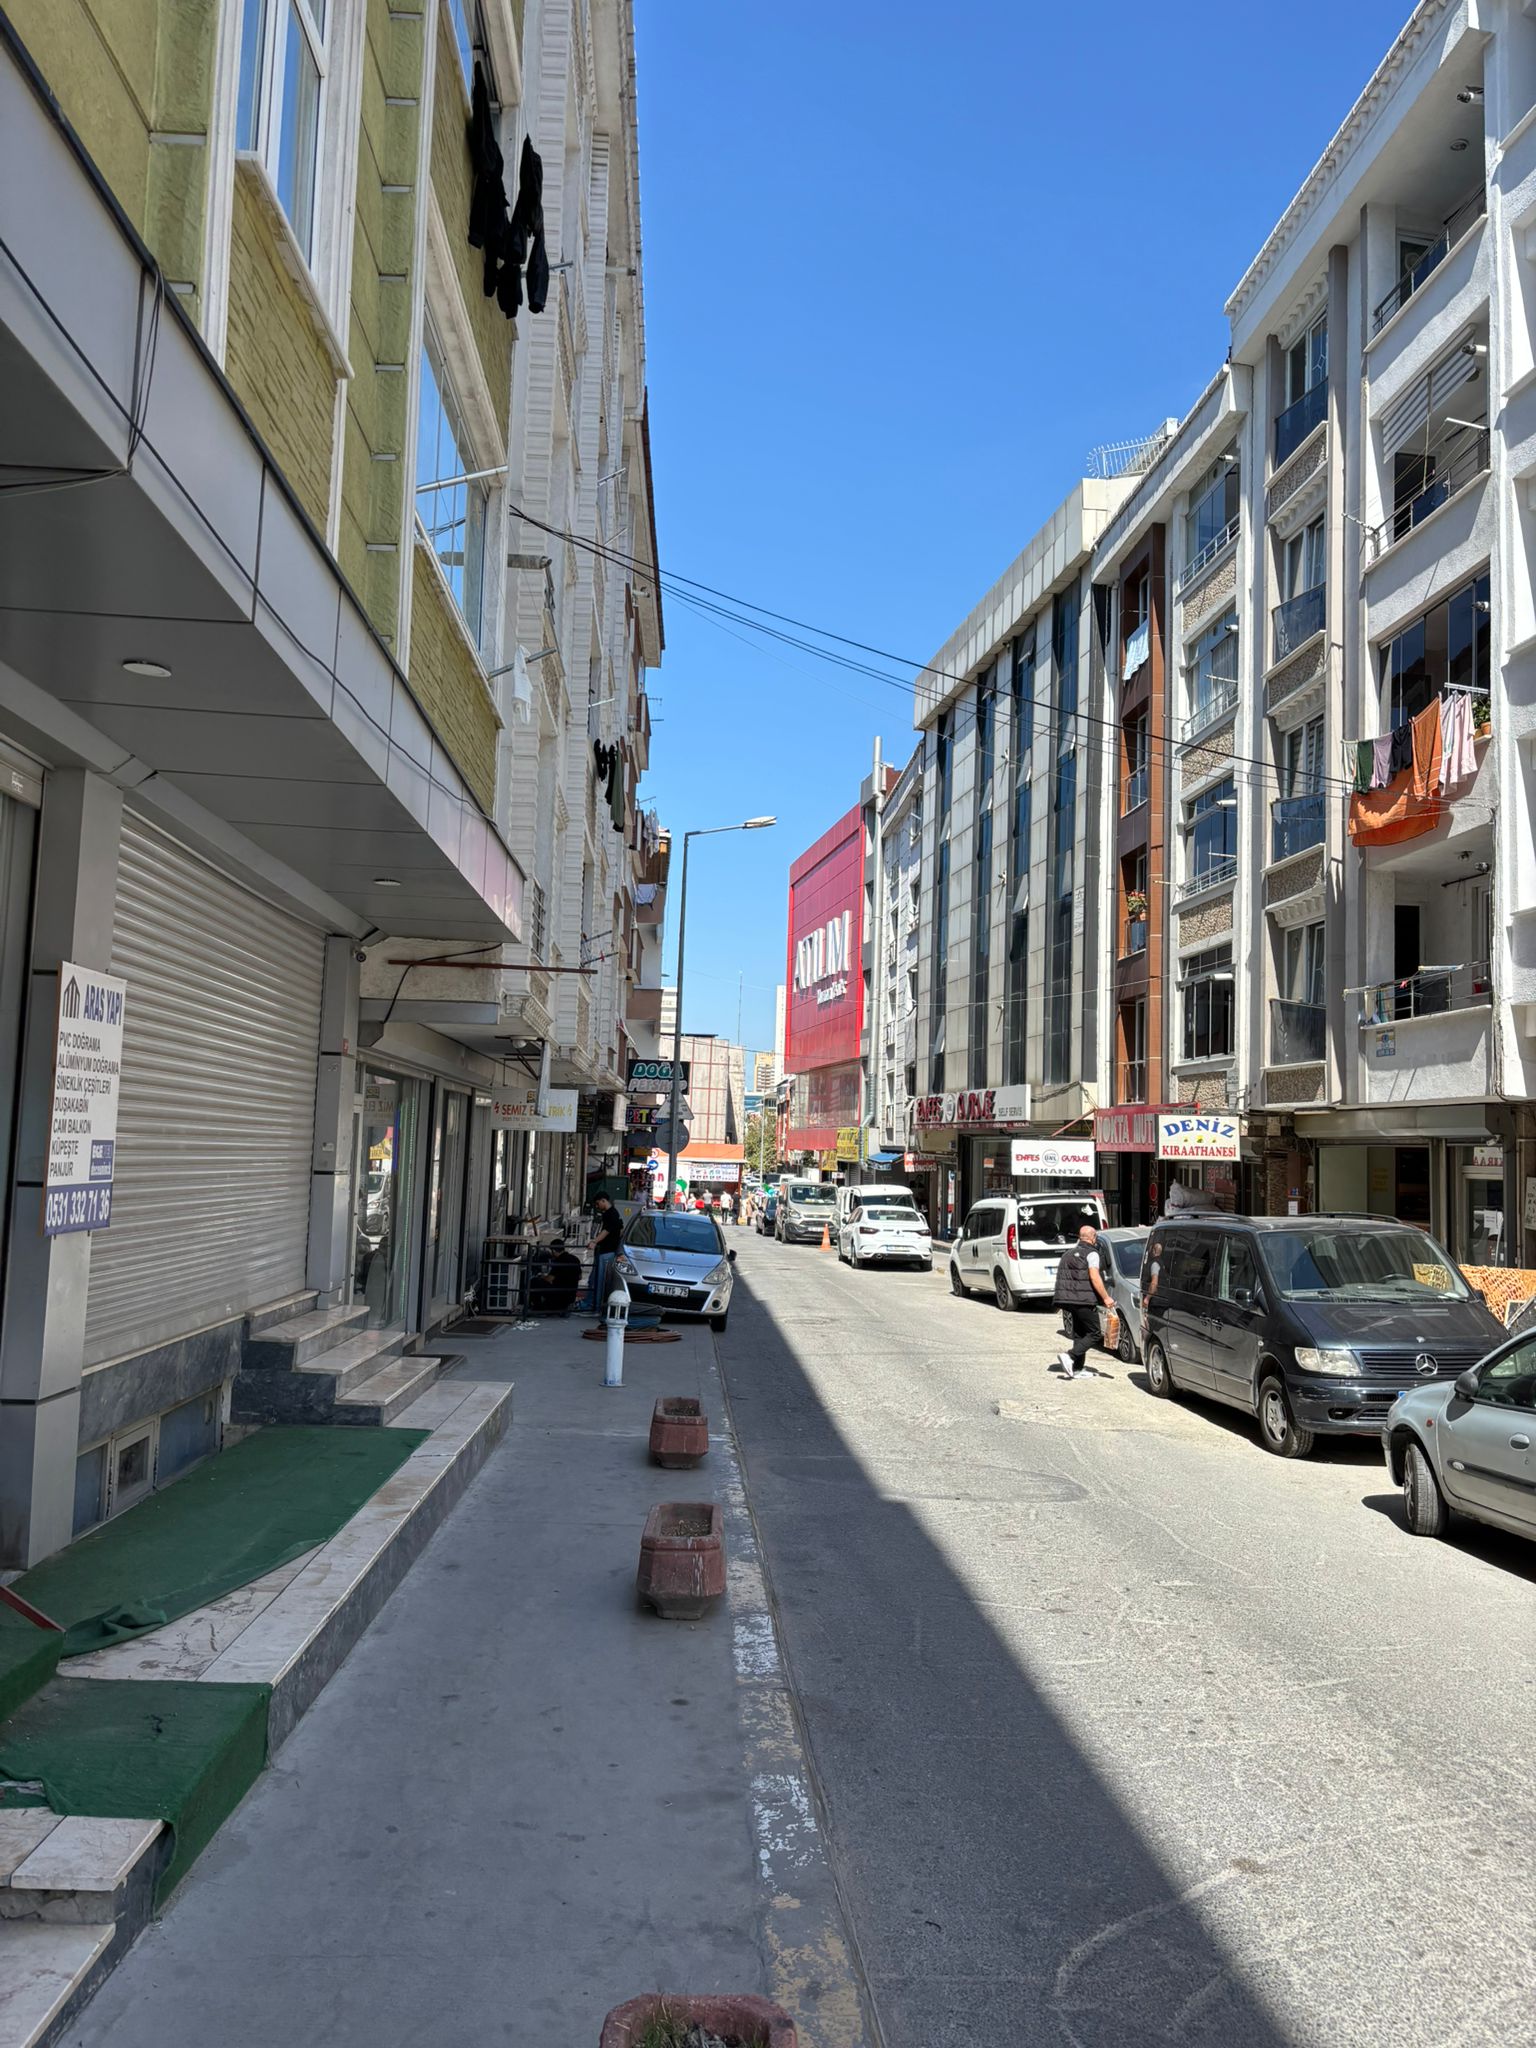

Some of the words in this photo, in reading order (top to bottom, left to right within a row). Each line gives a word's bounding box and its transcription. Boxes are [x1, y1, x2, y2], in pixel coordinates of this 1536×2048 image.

[83, 984, 104, 1022] ARAS
[106, 989, 123, 1026] YAPI
[59, 1031, 71, 1048] PVC
[72, 1032, 101, 1052] DOĞRAMA
[92, 1056, 119, 1075] DOĞRAMA
[56, 1071, 83, 1091] SİNEKLİK
[628, 1078, 687, 1093] PETSHP
[502, 1101, 526, 1116] SEMİZ
[529, 1103, 565, 1117] ETRİK
[627, 1108, 649, 1123] PET
[53, 1118, 67, 1133] CAM
[67, 1119, 92, 1134] BALKON
[1164, 1118, 1236, 1138] DENİZ
[51, 1137, 79, 1158] KÜPEŞTE
[1162, 1144, 1237, 1157] KIRAATHANESİ
[49, 1161, 74, 1177] PANJUR
[1023, 1167, 1083, 1175] LOKANTA
[46, 1192, 69, 1227] 0531
[70, 1190, 87, 1224] 332
[87, 1189, 98, 1222] 71
[99, 1189, 110, 1221] 36
